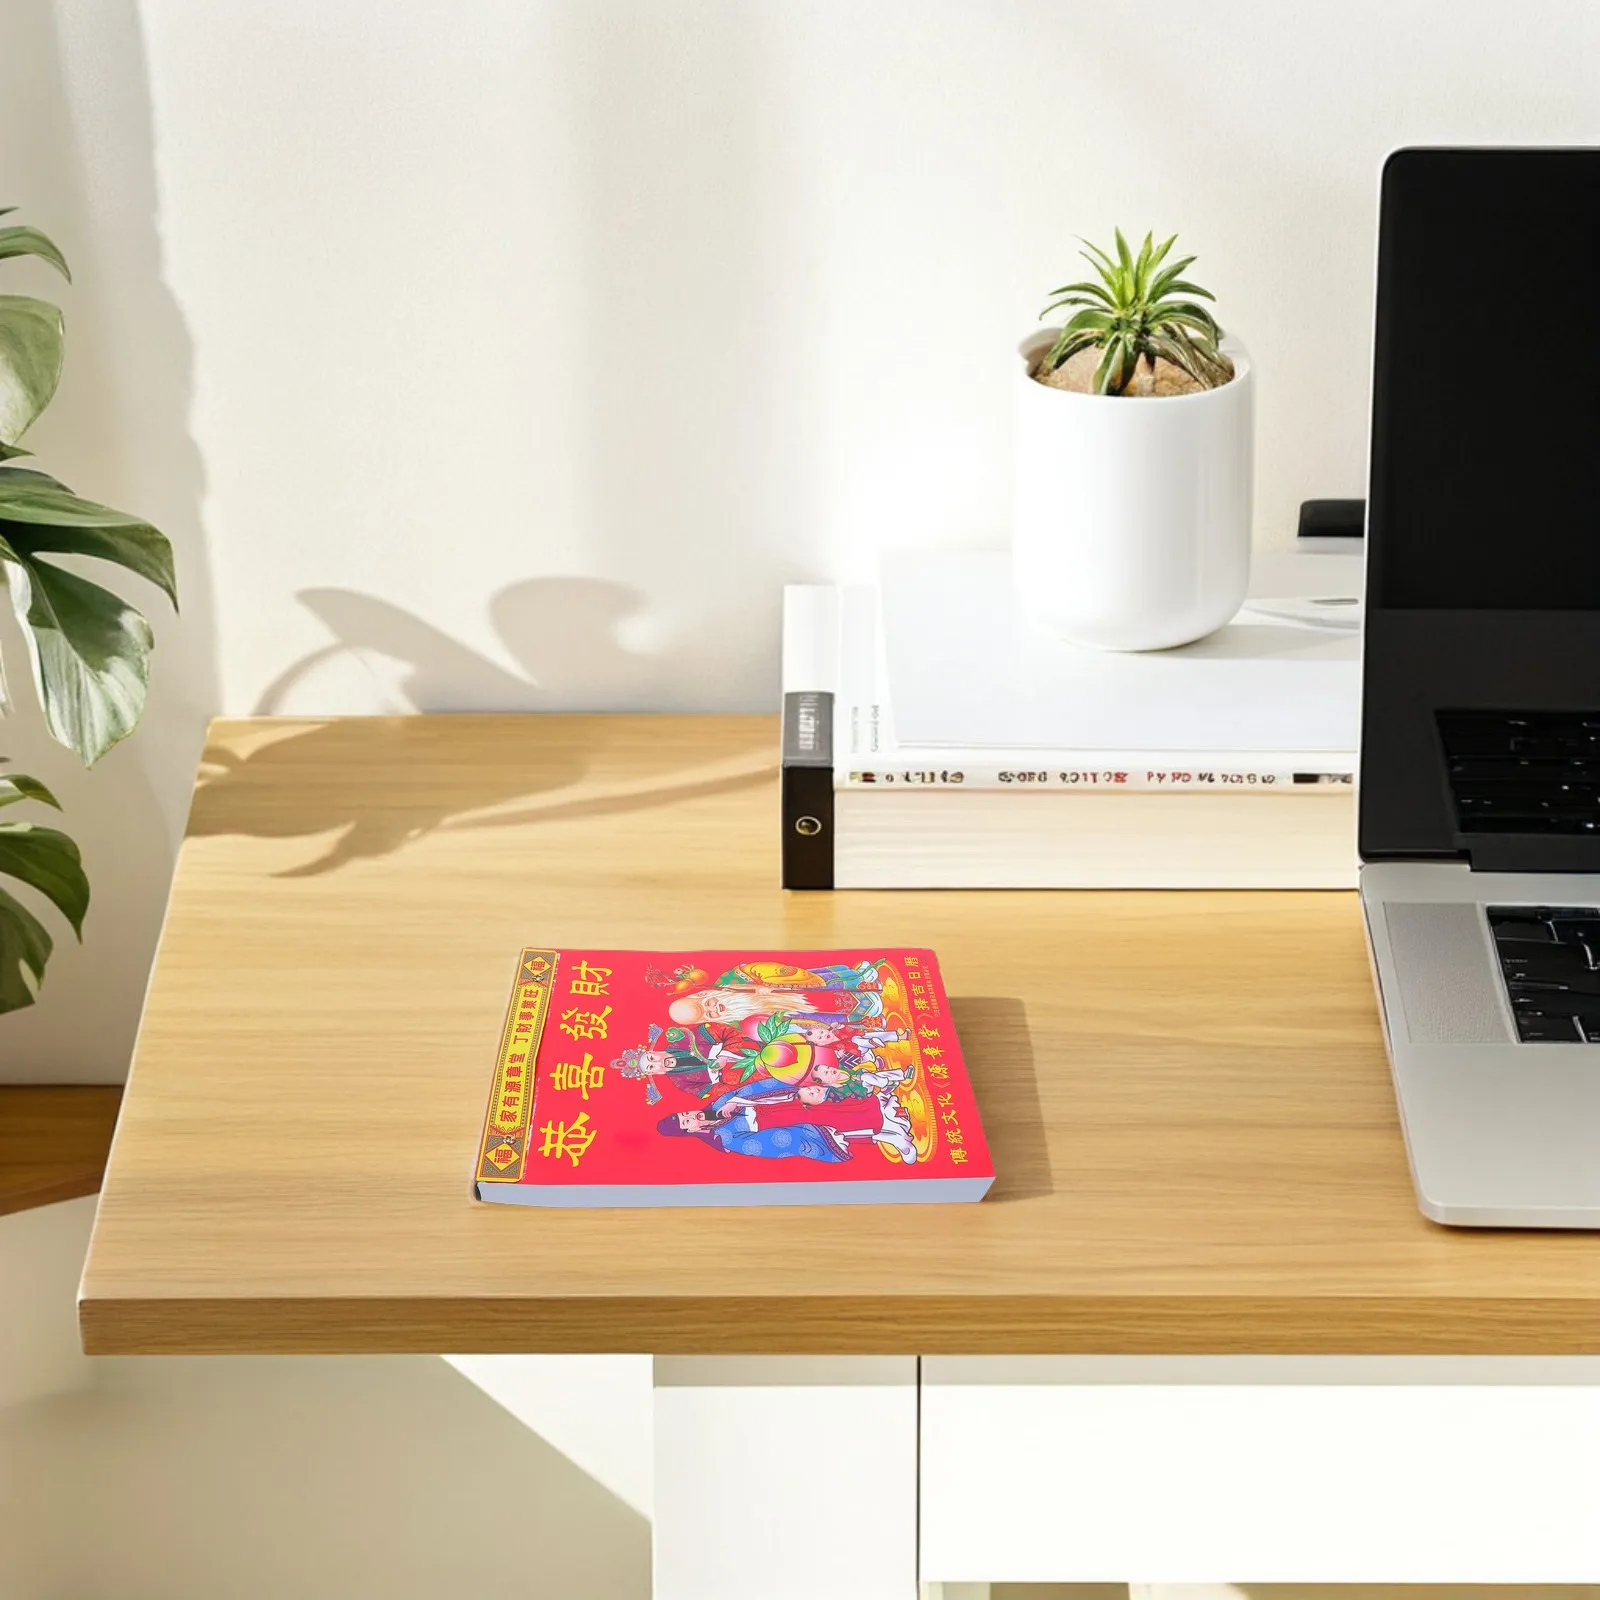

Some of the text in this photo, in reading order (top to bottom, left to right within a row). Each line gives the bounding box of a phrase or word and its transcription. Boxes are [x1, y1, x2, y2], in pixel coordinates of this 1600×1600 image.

[513, 988, 539, 1044] 丁財事業旺
[499, 1052, 526, 1123] 家有源章堂
[537, 959, 613, 1167] 恭喜發財
[493, 1148, 513, 1164] 福
